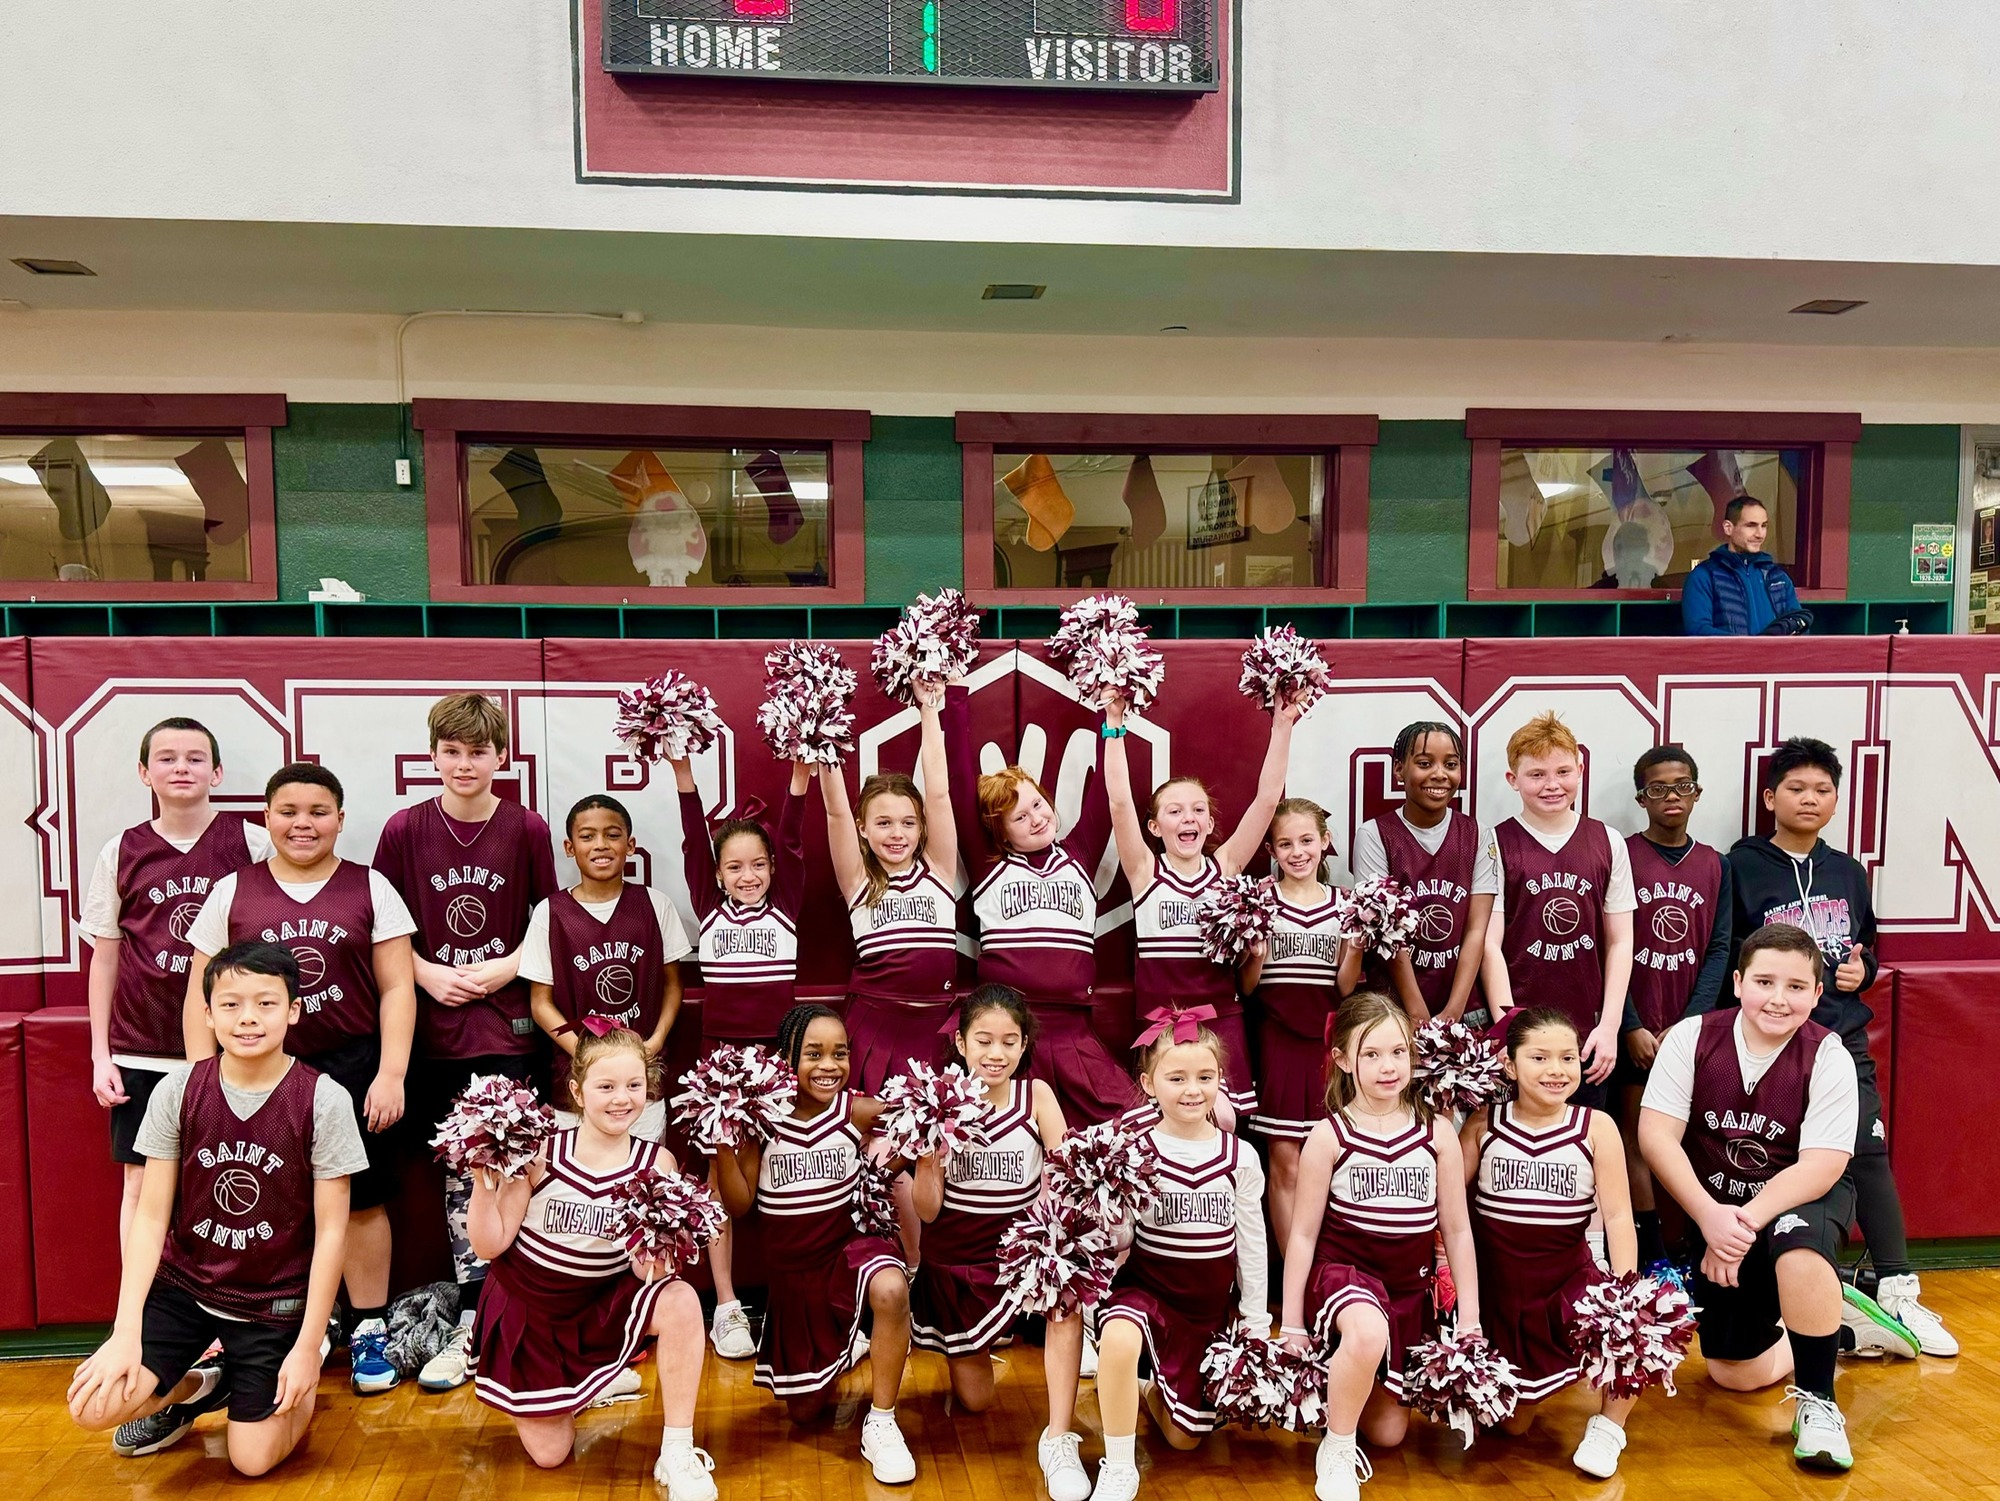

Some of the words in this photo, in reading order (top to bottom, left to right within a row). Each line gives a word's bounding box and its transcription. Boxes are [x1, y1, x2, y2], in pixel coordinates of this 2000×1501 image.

[650, 24, 781, 70] HOME
[1024, 38, 1193, 84] VISITOR
[148, 877, 218, 904] SAIN
[431, 866, 505, 892] SAINT
[1526, 871, 1593, 897] SAINT
[1001, 881, 1084, 920] CRUSADERS
[1638, 882, 1705, 909] SAINT
[1764, 905, 1786, 917] SAINT
[1808, 894, 1829, 903] CHOOL
[870, 896, 938, 930] CRUSADERS
[1159, 901, 1201, 930] CRUSA
[261, 919, 348, 944] SAINT
[712, 928, 777, 959] CRUSADERS
[436, 937, 506, 966] ANN'S
[573, 942, 644, 972] SAINT
[1271, 933, 1337, 964] CRUSADERS
[1527, 934, 1595, 962] ANN'S
[1634, 947, 1696, 971] ANN'S
[303, 984, 343, 1014] N'S
[1704, 1110, 1786, 1140] SAINT
[198, 1140, 284, 1175] SAINT
[769, 1148, 847, 1189] CRUSADERS
[949, 1150, 1024, 1184] CRUSADERS
[1349, 1166, 1430, 1202] CRUSADERS
[1491, 1157, 1577, 1198] CRUSADERS
[1708, 1172, 1764, 1197] ANN
[544, 1198, 617, 1242] CRUSADE
[1154, 1191, 1232, 1227] CRUSADERS
[192, 1218, 273, 1250] ANN'S
